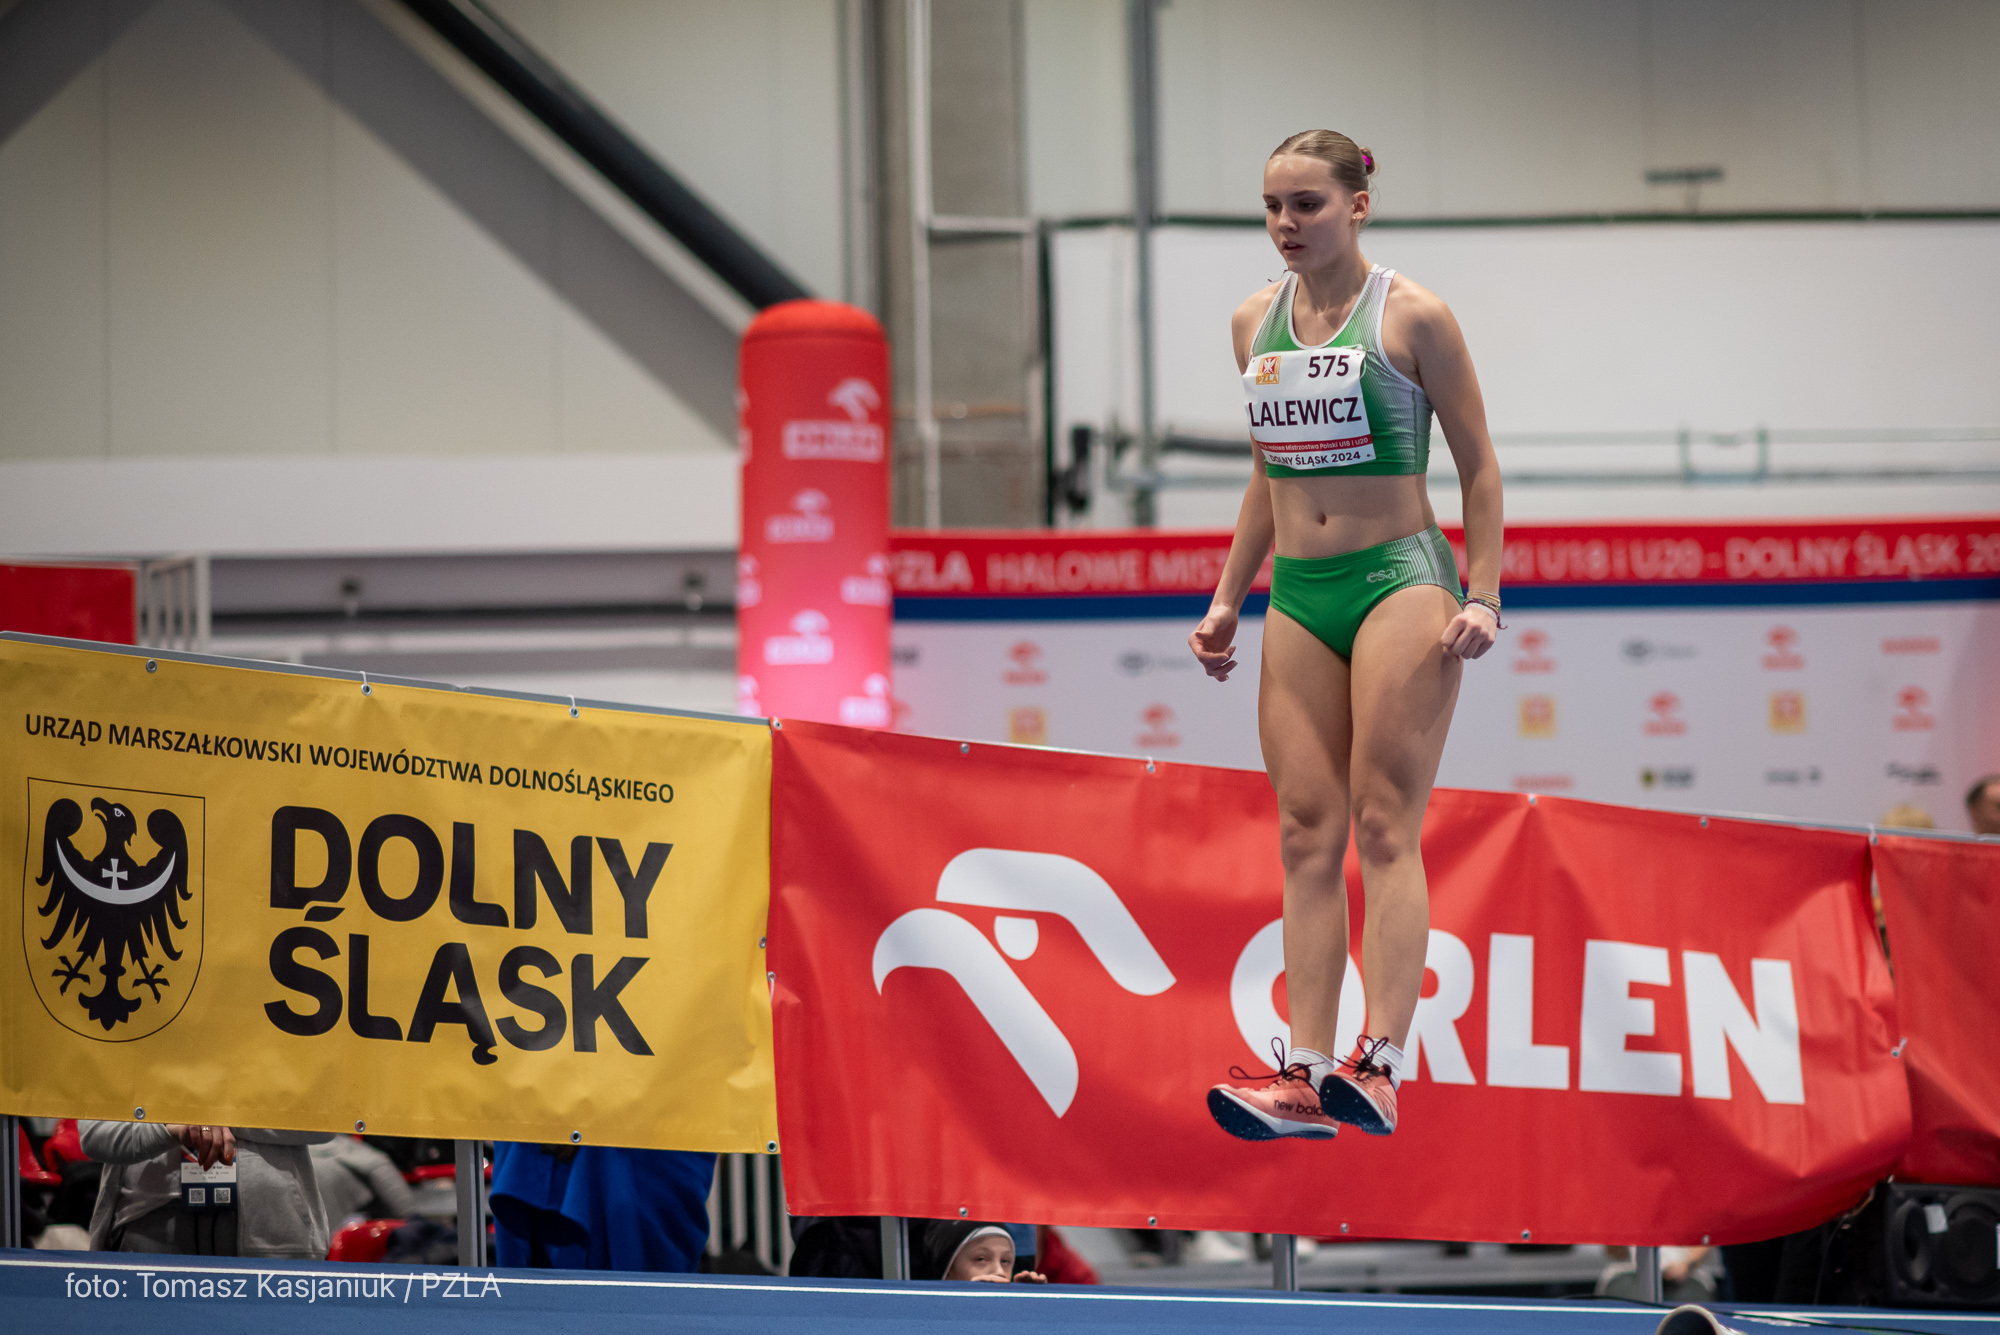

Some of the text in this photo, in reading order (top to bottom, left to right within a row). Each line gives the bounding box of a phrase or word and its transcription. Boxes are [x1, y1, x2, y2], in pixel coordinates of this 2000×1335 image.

[1308, 355, 1350, 378] 575
[1257, 374, 1279, 384] PZLA
[1248, 396, 1363, 427] LALEWICZ
[1286, 443, 1319, 451] Mistrzostwa
[1355, 437, 1369, 445] U20
[1269, 451, 1361, 467] DOLNY ŚLĄSK 2024
[26, 714, 674, 803] URZĄD MARSZAŁKOWSKI WOJEWÓDZTWA DOLNOŚLĄSKIEGO
[270, 805, 674, 939] DOLNY
[263, 906, 655, 1066] ŚLĄSK
[1274, 1100, 1326, 1117] new bala
